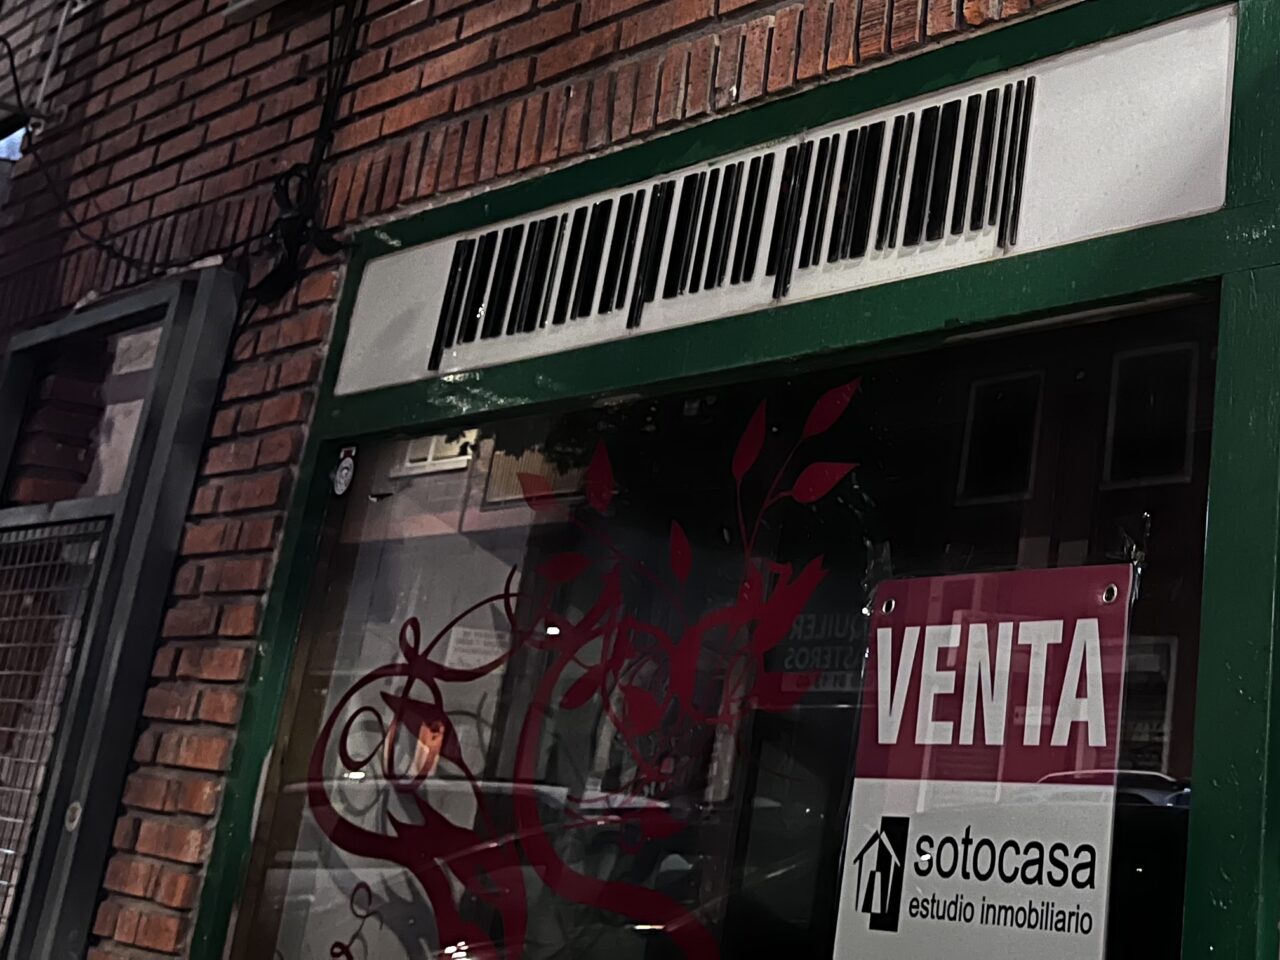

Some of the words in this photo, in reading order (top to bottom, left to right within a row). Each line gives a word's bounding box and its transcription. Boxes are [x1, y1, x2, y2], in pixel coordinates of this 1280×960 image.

[876, 618, 1107, 747] VENTA
[912, 825, 1096, 889] sotocasa
[908, 894, 975, 924] estudio
[979, 896, 1093, 935] inmobiliario
